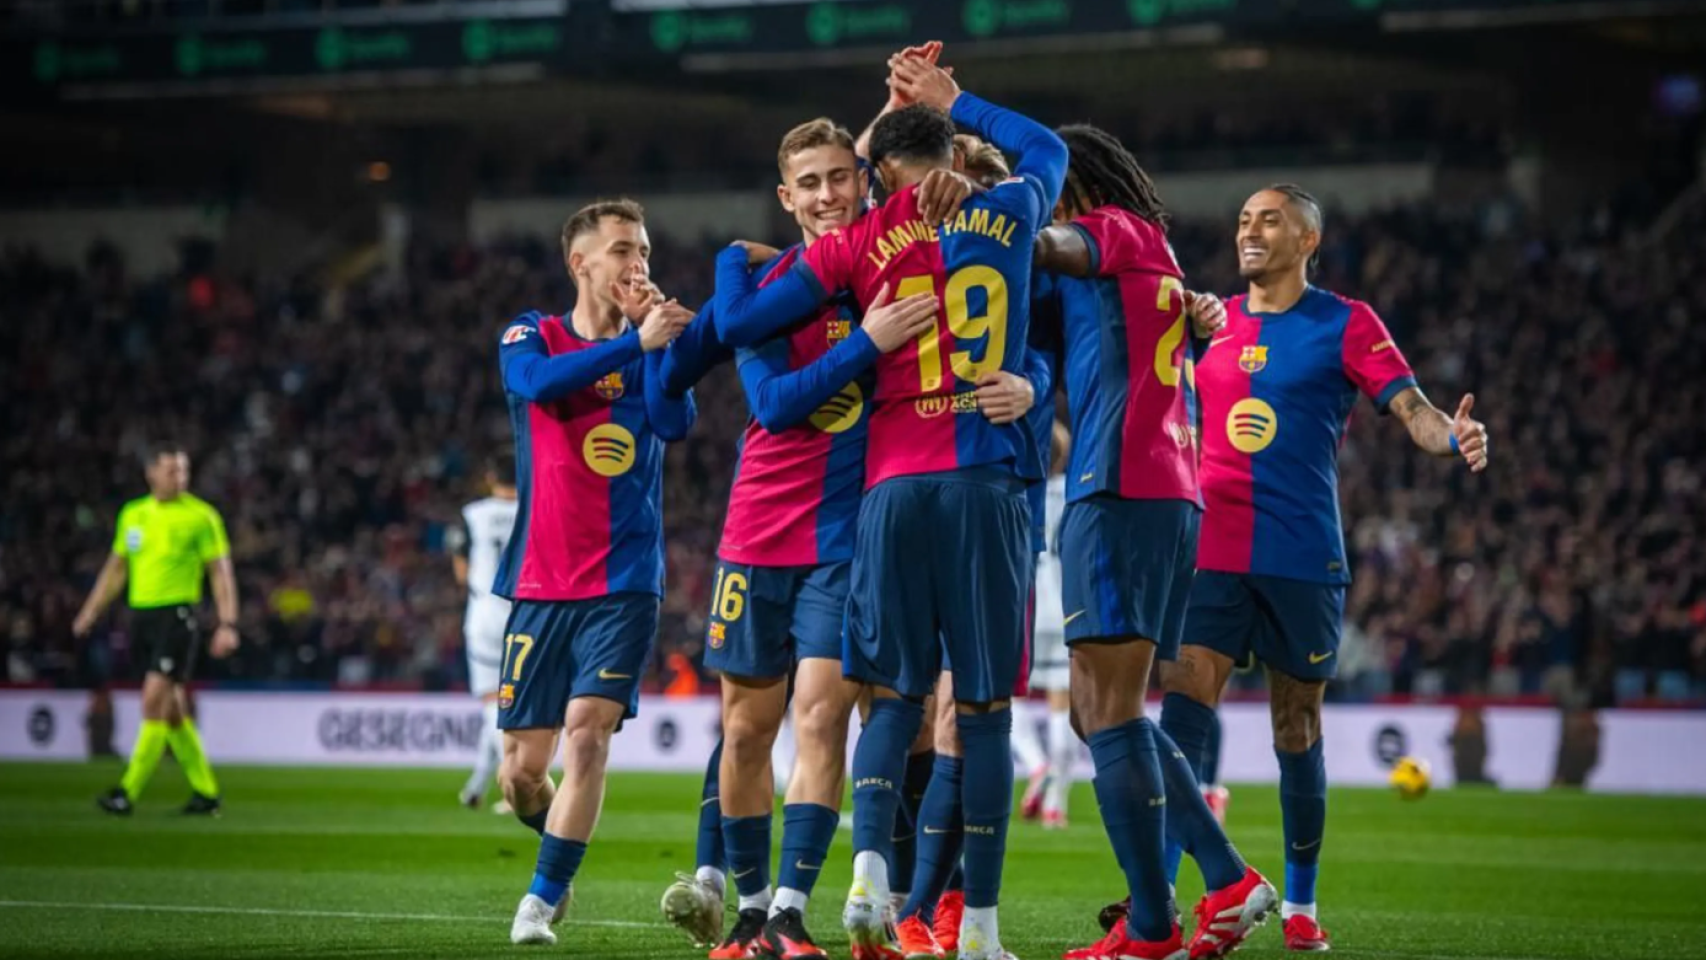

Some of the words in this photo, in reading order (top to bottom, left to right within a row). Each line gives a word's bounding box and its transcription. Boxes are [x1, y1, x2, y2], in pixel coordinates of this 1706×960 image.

[868, 219, 939, 270] LAMINE
[943, 208, 1018, 248] YAMAL
[895, 265, 1008, 393] 19
[1153, 275, 1195, 390] 2
[711, 566, 748, 622] 16
[502, 632, 535, 681] 17
[318, 706, 485, 752] GESEGNE
